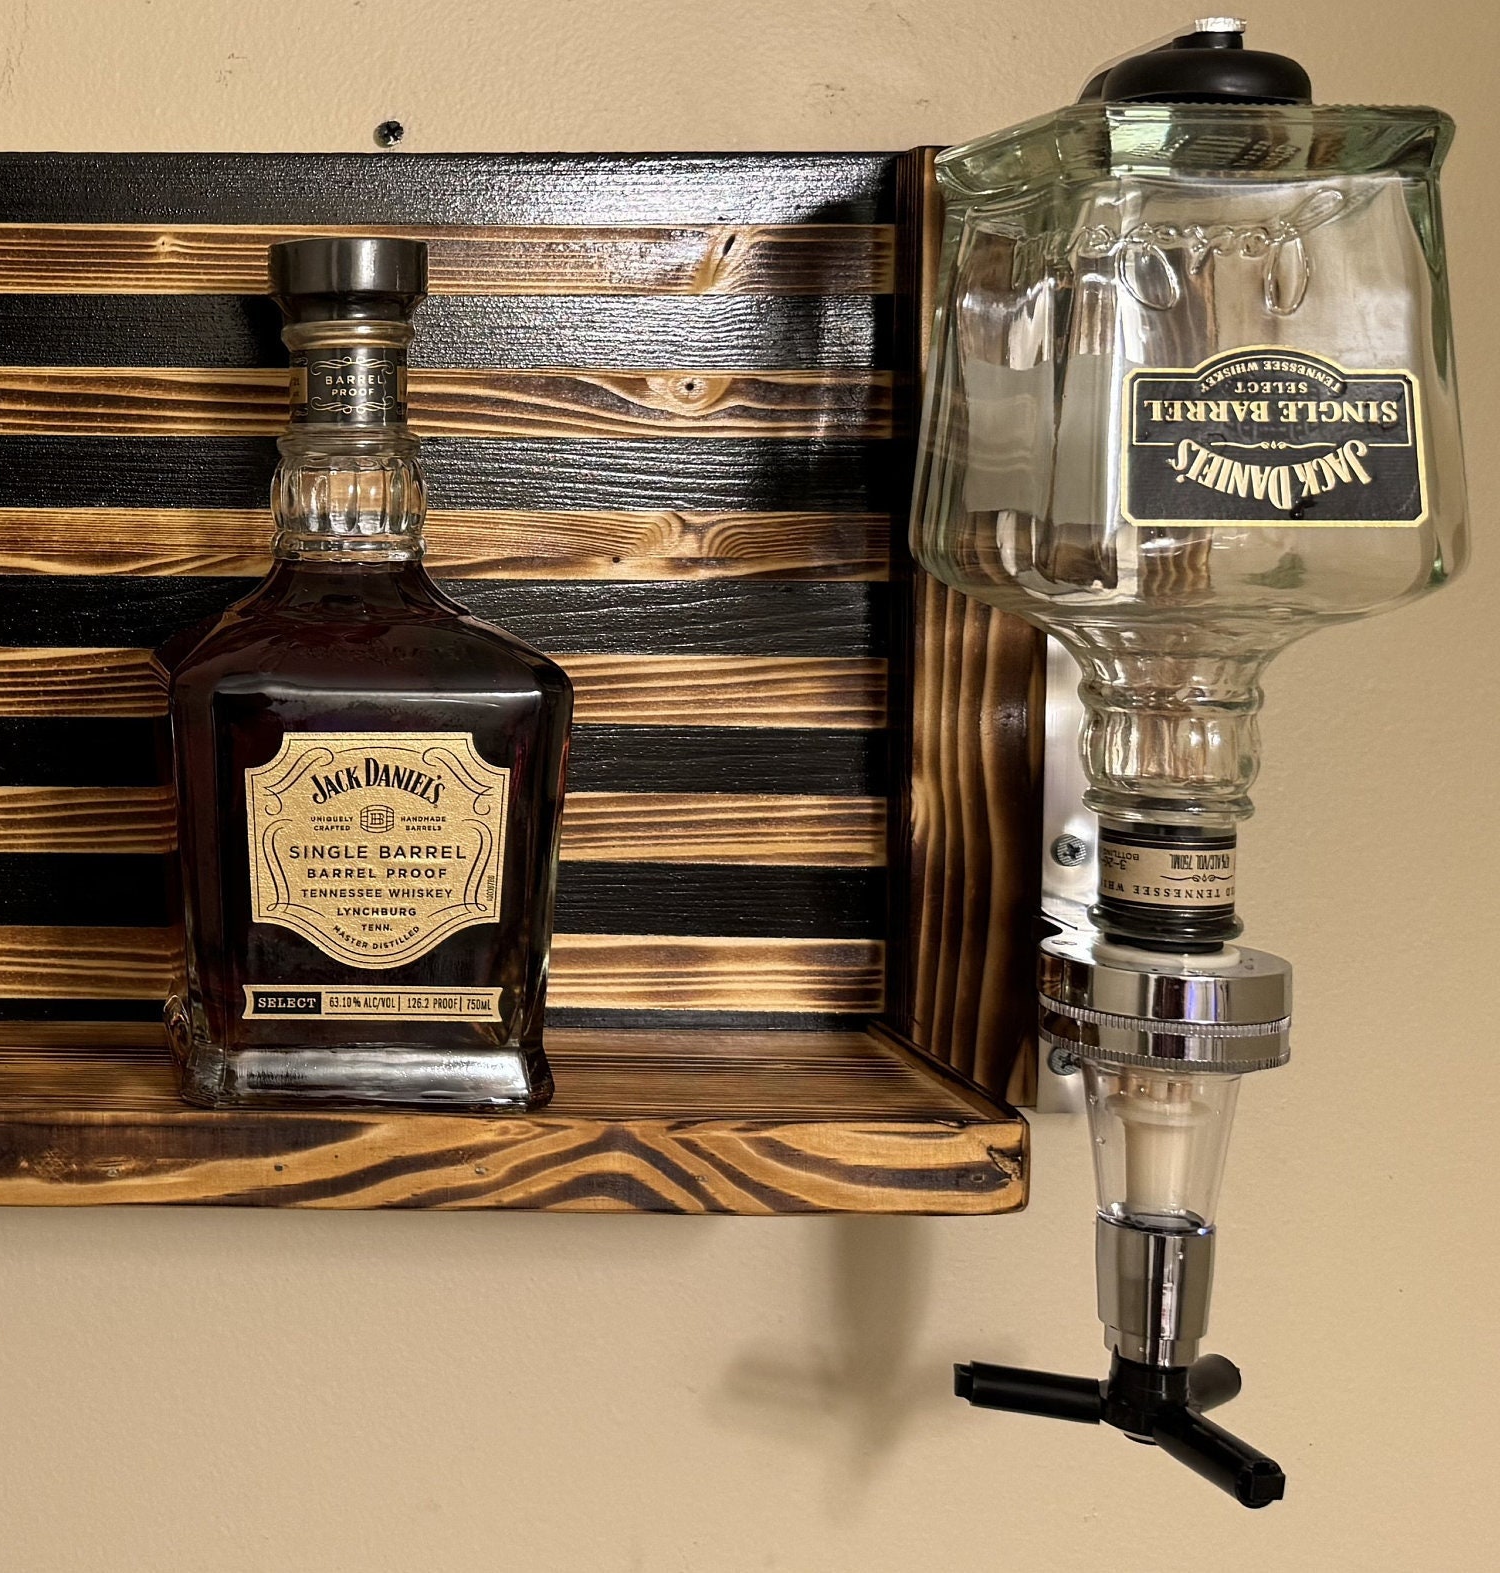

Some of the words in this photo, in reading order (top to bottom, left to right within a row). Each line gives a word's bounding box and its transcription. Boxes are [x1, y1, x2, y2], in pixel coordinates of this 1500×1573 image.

[325, 375, 384, 385] BARREL
[1201, 361, 1257, 393] WHISKEY
[1263, 361, 1340, 392] TENNESSEE
[331, 389, 375, 397] PROOF
[1235, 382, 1308, 393] SELECT
[1144, 400, 1269, 422] BARREL
[1280, 401, 1398, 423] SINGLE
[1172, 439, 1294, 510] DANIEL'S
[1295, 440, 1372, 497] JACK
[311, 767, 363, 804] JACK
[364, 757, 446, 806] DANIEL'S
[289, 845, 368, 860] SINGLE
[379, 845, 467, 860] BARREL
[307, 868, 377, 879] BARREL
[386, 868, 447, 879] PROOF
[301, 888, 383, 898] TENNESSEE
[388, 888, 453, 898] WHISKEY
[1133, 884, 1220, 899] TENNESSEE
[337, 907, 417, 917] LYNCHBURG
[361, 924, 393, 932] TENN.
[332, 925, 368, 949] MASTER
[372, 925, 421, 950] DISTILLED
[258, 997, 317, 1009] SELECT
[363, 996, 395, 1009] ALC/VOL
[407, 998, 429, 1009] 126.2
[433, 998, 458, 1010] PROOF
